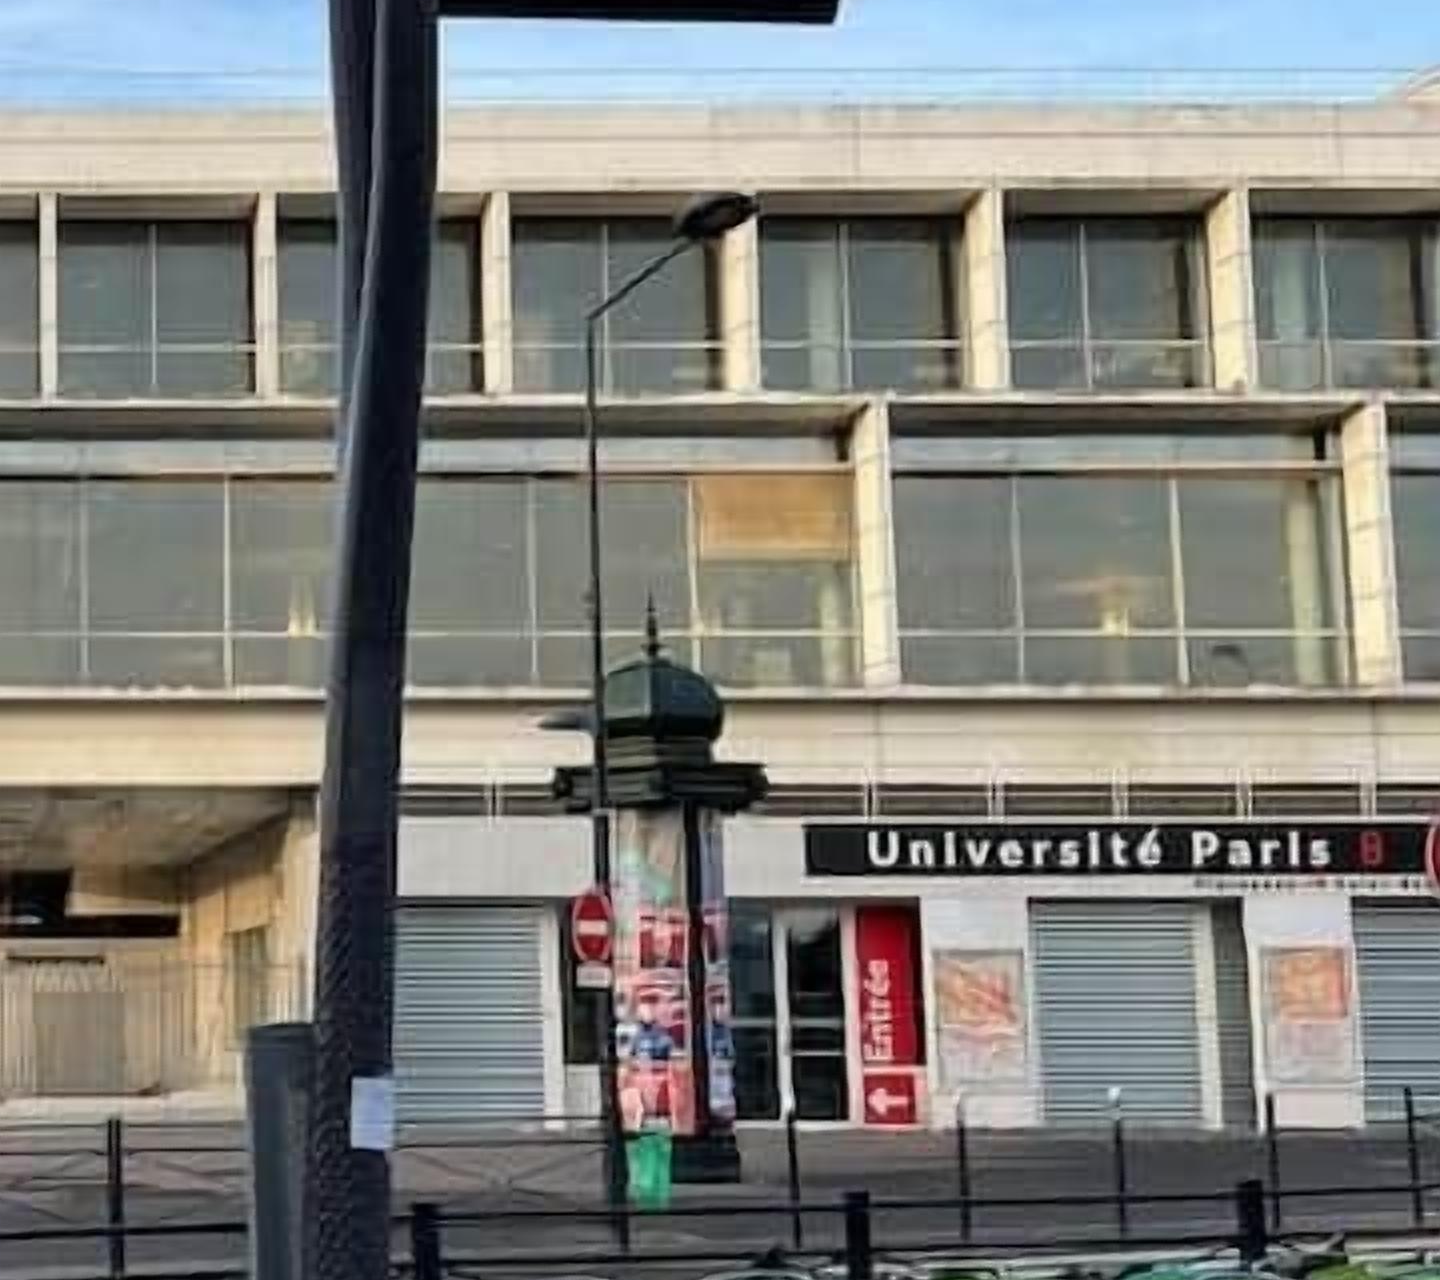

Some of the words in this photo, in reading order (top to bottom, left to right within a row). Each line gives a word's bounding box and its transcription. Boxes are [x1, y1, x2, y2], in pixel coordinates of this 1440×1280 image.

[867, 827, 1162, 868] Université
[1191, 830, 1331, 867] Paris
[863, 959, 894, 1061] Entrée
